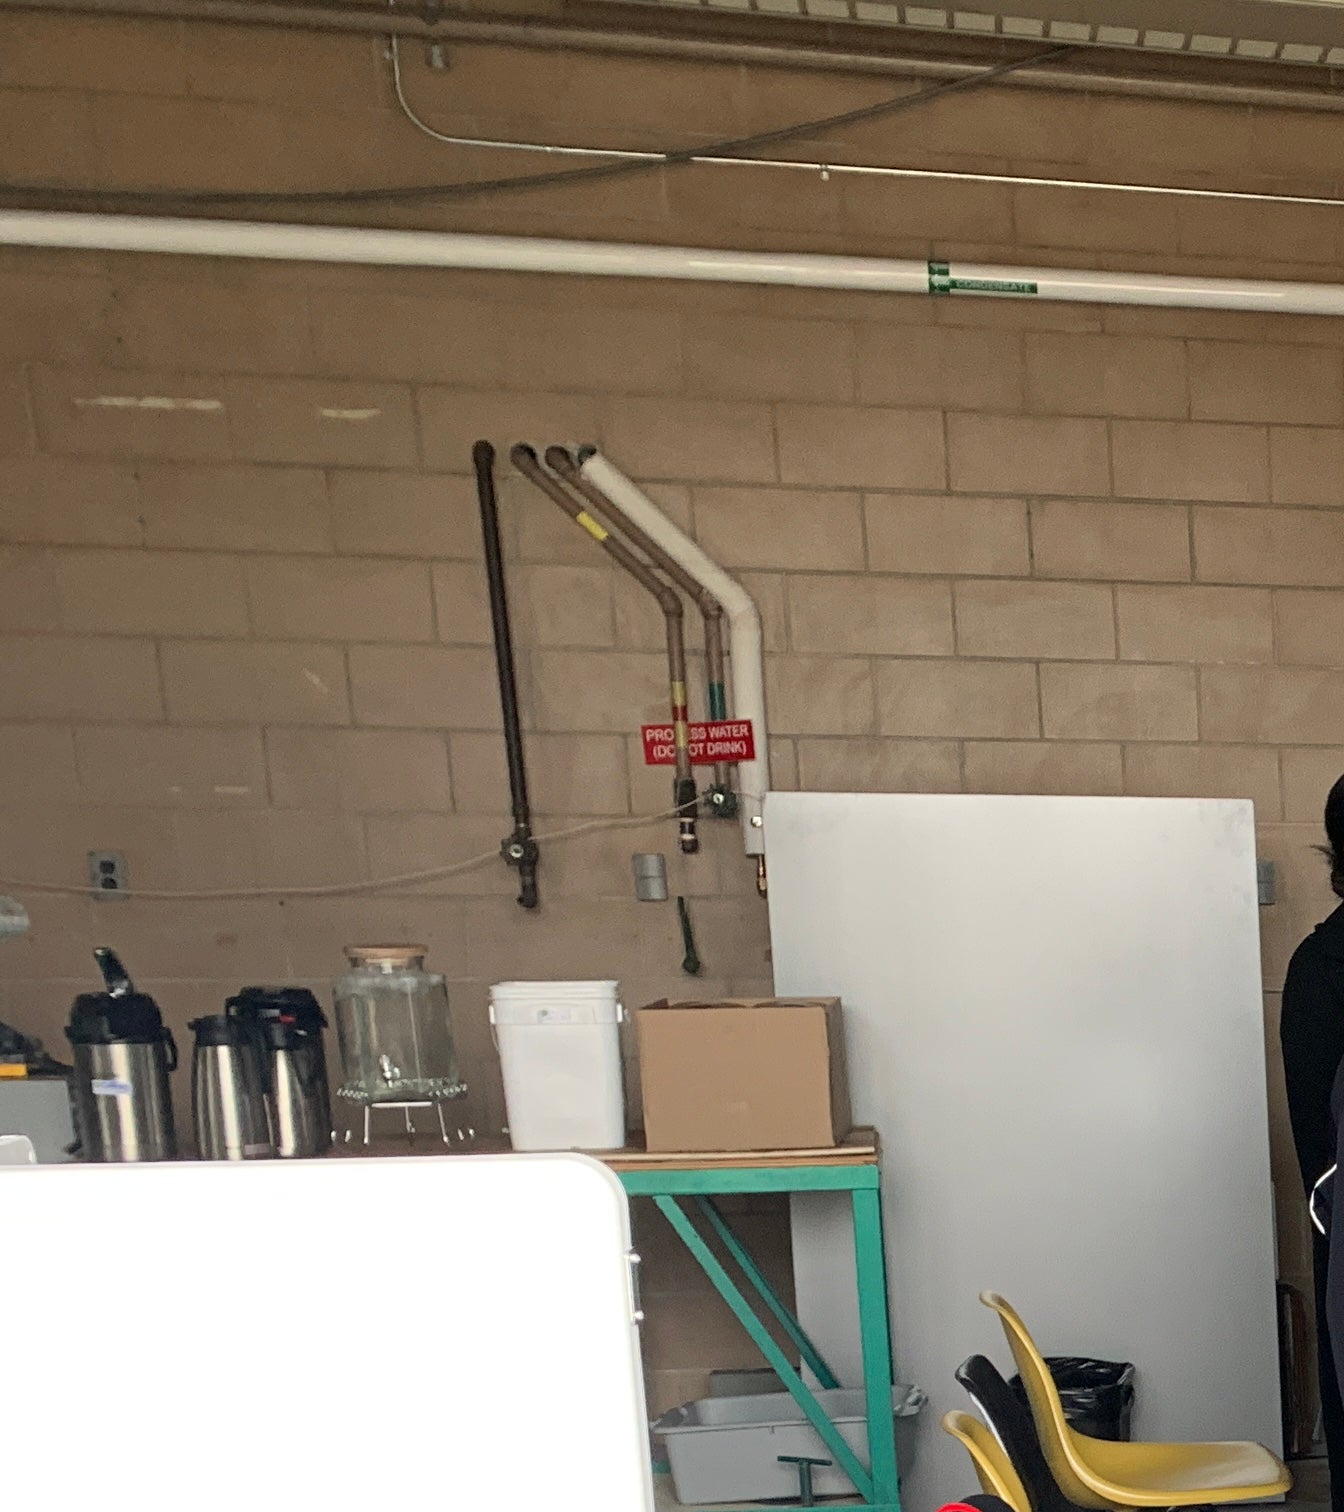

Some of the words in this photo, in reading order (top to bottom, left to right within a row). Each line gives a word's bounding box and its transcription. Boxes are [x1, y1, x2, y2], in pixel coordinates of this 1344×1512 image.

[646, 726, 707, 742] PROSS
[708, 724, 749, 739] WATER
[707, 741, 747, 756] DRINK)
